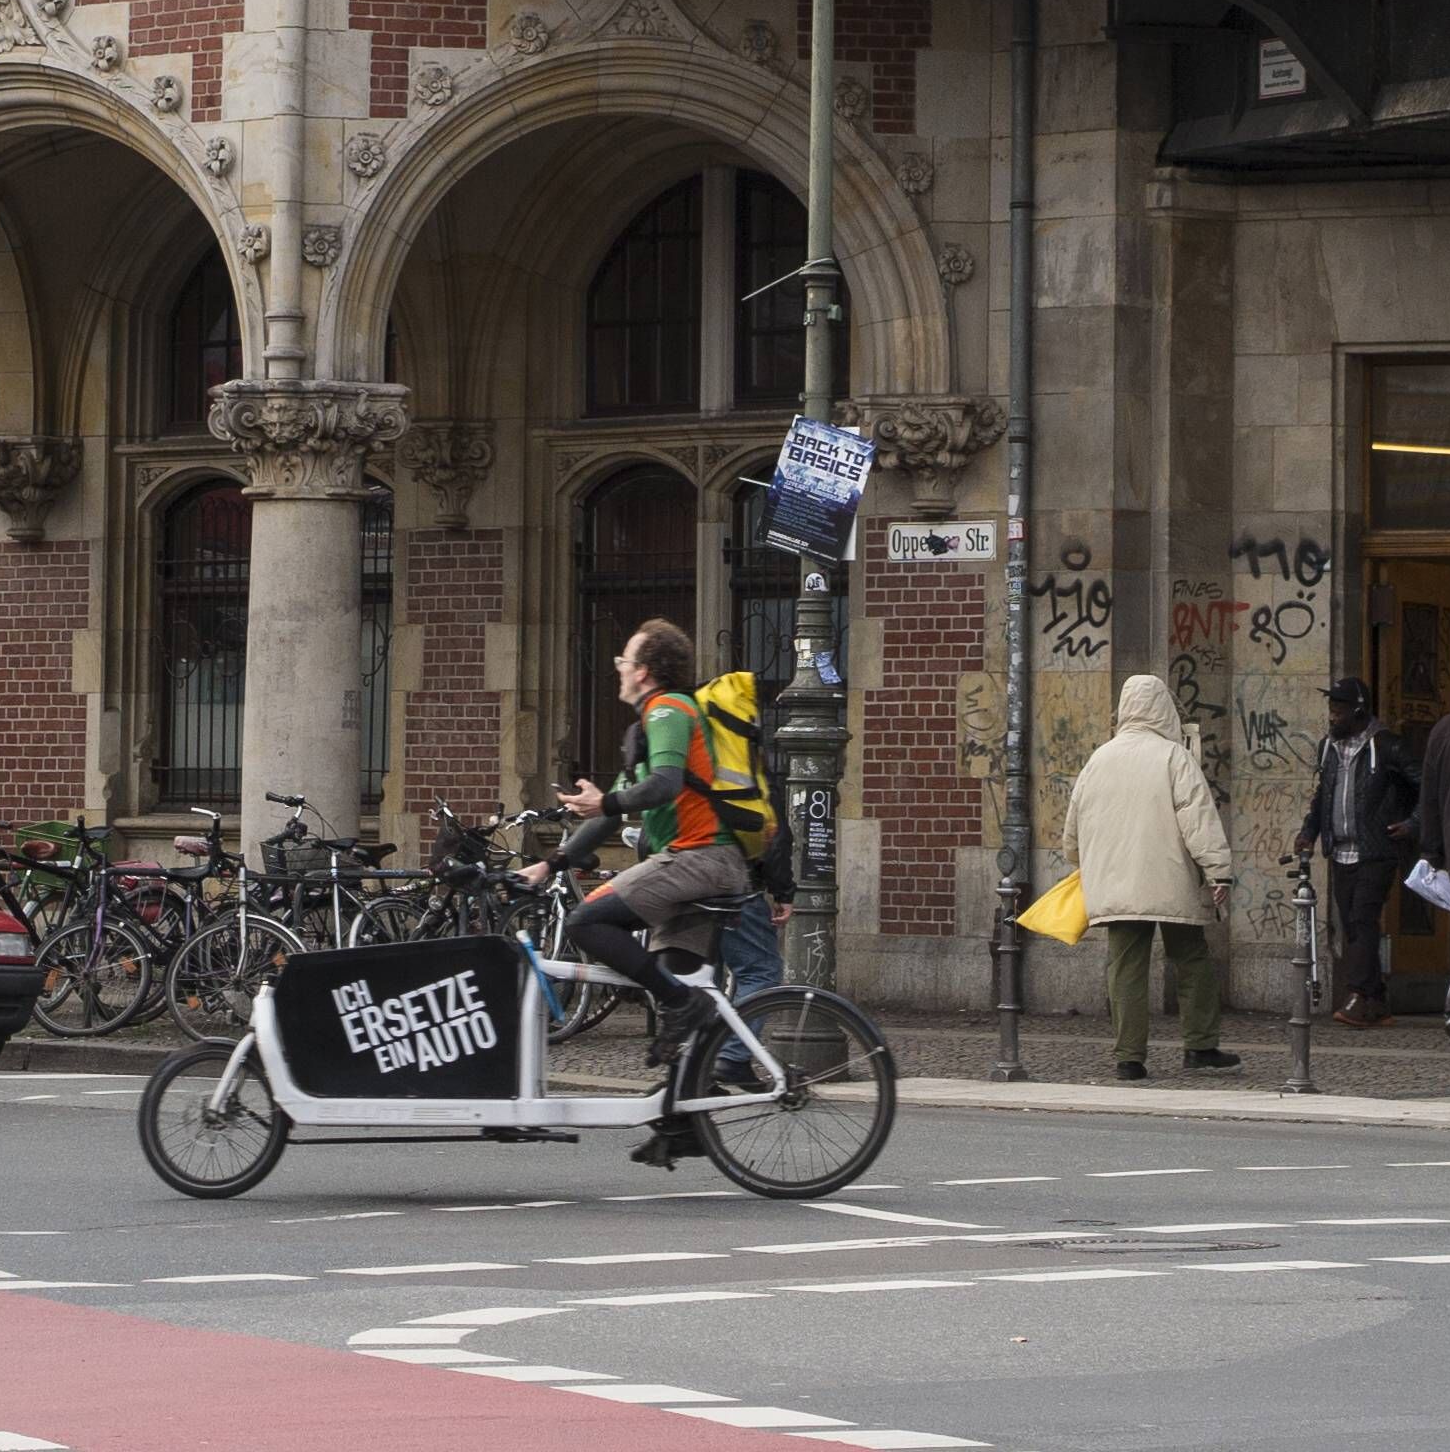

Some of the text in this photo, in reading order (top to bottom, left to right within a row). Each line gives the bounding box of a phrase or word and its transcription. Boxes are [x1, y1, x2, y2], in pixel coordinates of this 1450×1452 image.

[787, 448, 863, 482] BASICS
[793, 433, 866, 466] BACK TO
[966, 528, 989, 551] Str.
[809, 790, 831, 819] 81
[331, 979, 373, 1014] ICH
[340, 970, 486, 1053] ERSETZE
[374, 1011, 498, 1073] EIN AUTO
